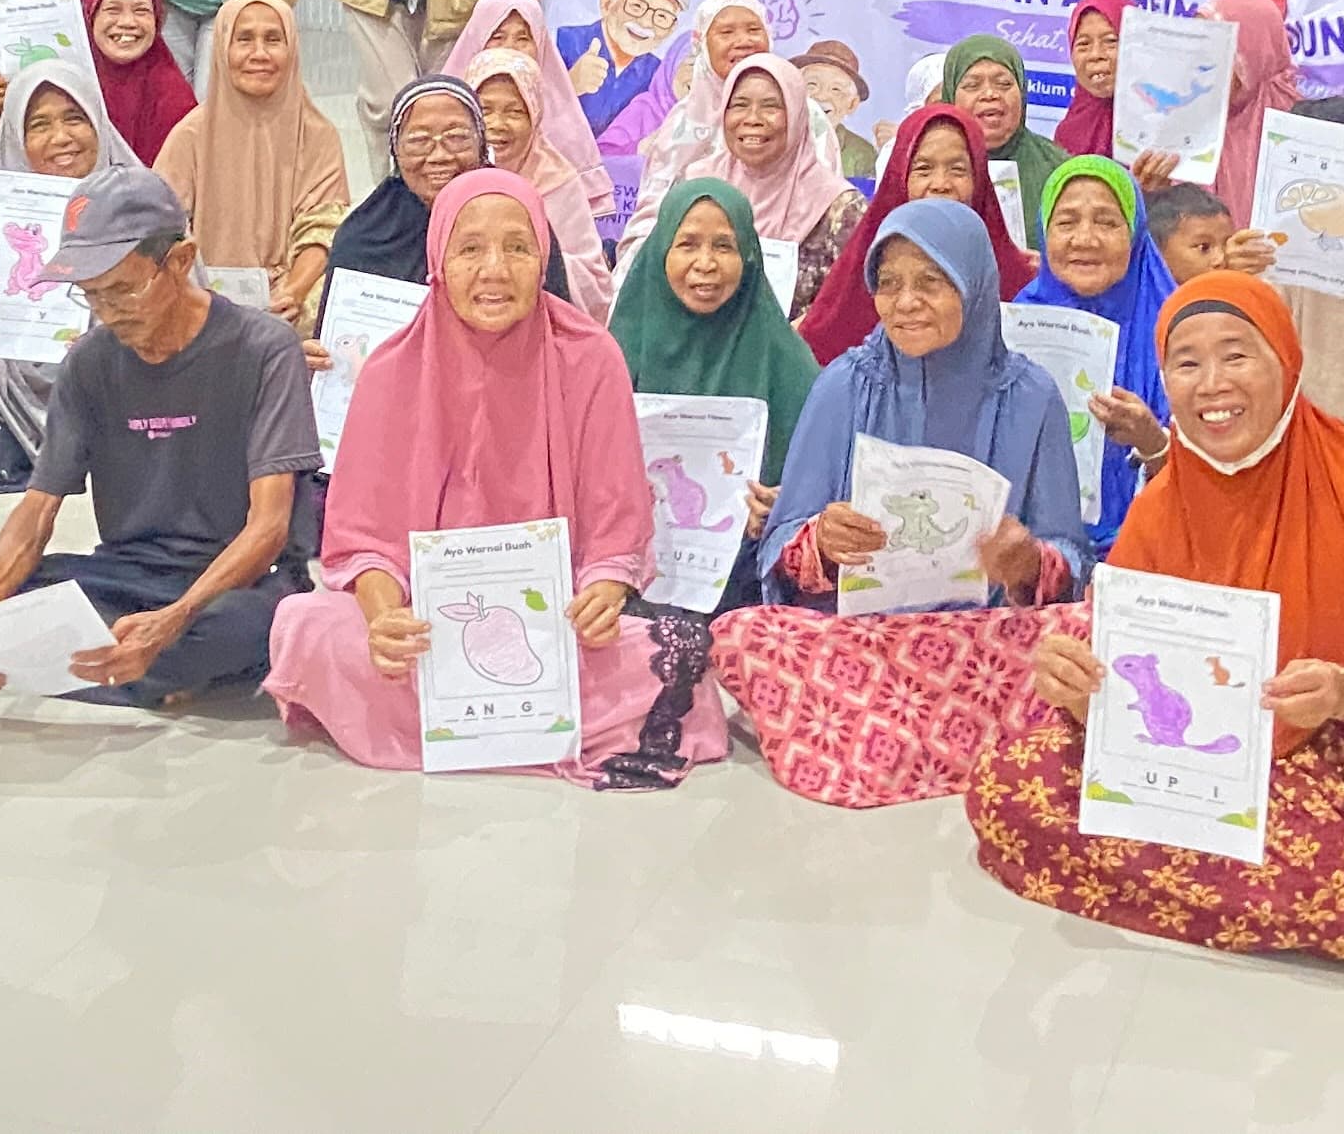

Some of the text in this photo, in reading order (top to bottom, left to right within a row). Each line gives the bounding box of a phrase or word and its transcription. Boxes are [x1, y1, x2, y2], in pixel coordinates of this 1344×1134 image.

[443, 540, 533, 558] Ayo Warnai Buah
[465, 701, 533, 716] A N G
[1145, 771, 1158, 785] U
[1168, 775, 1179, 789] P
